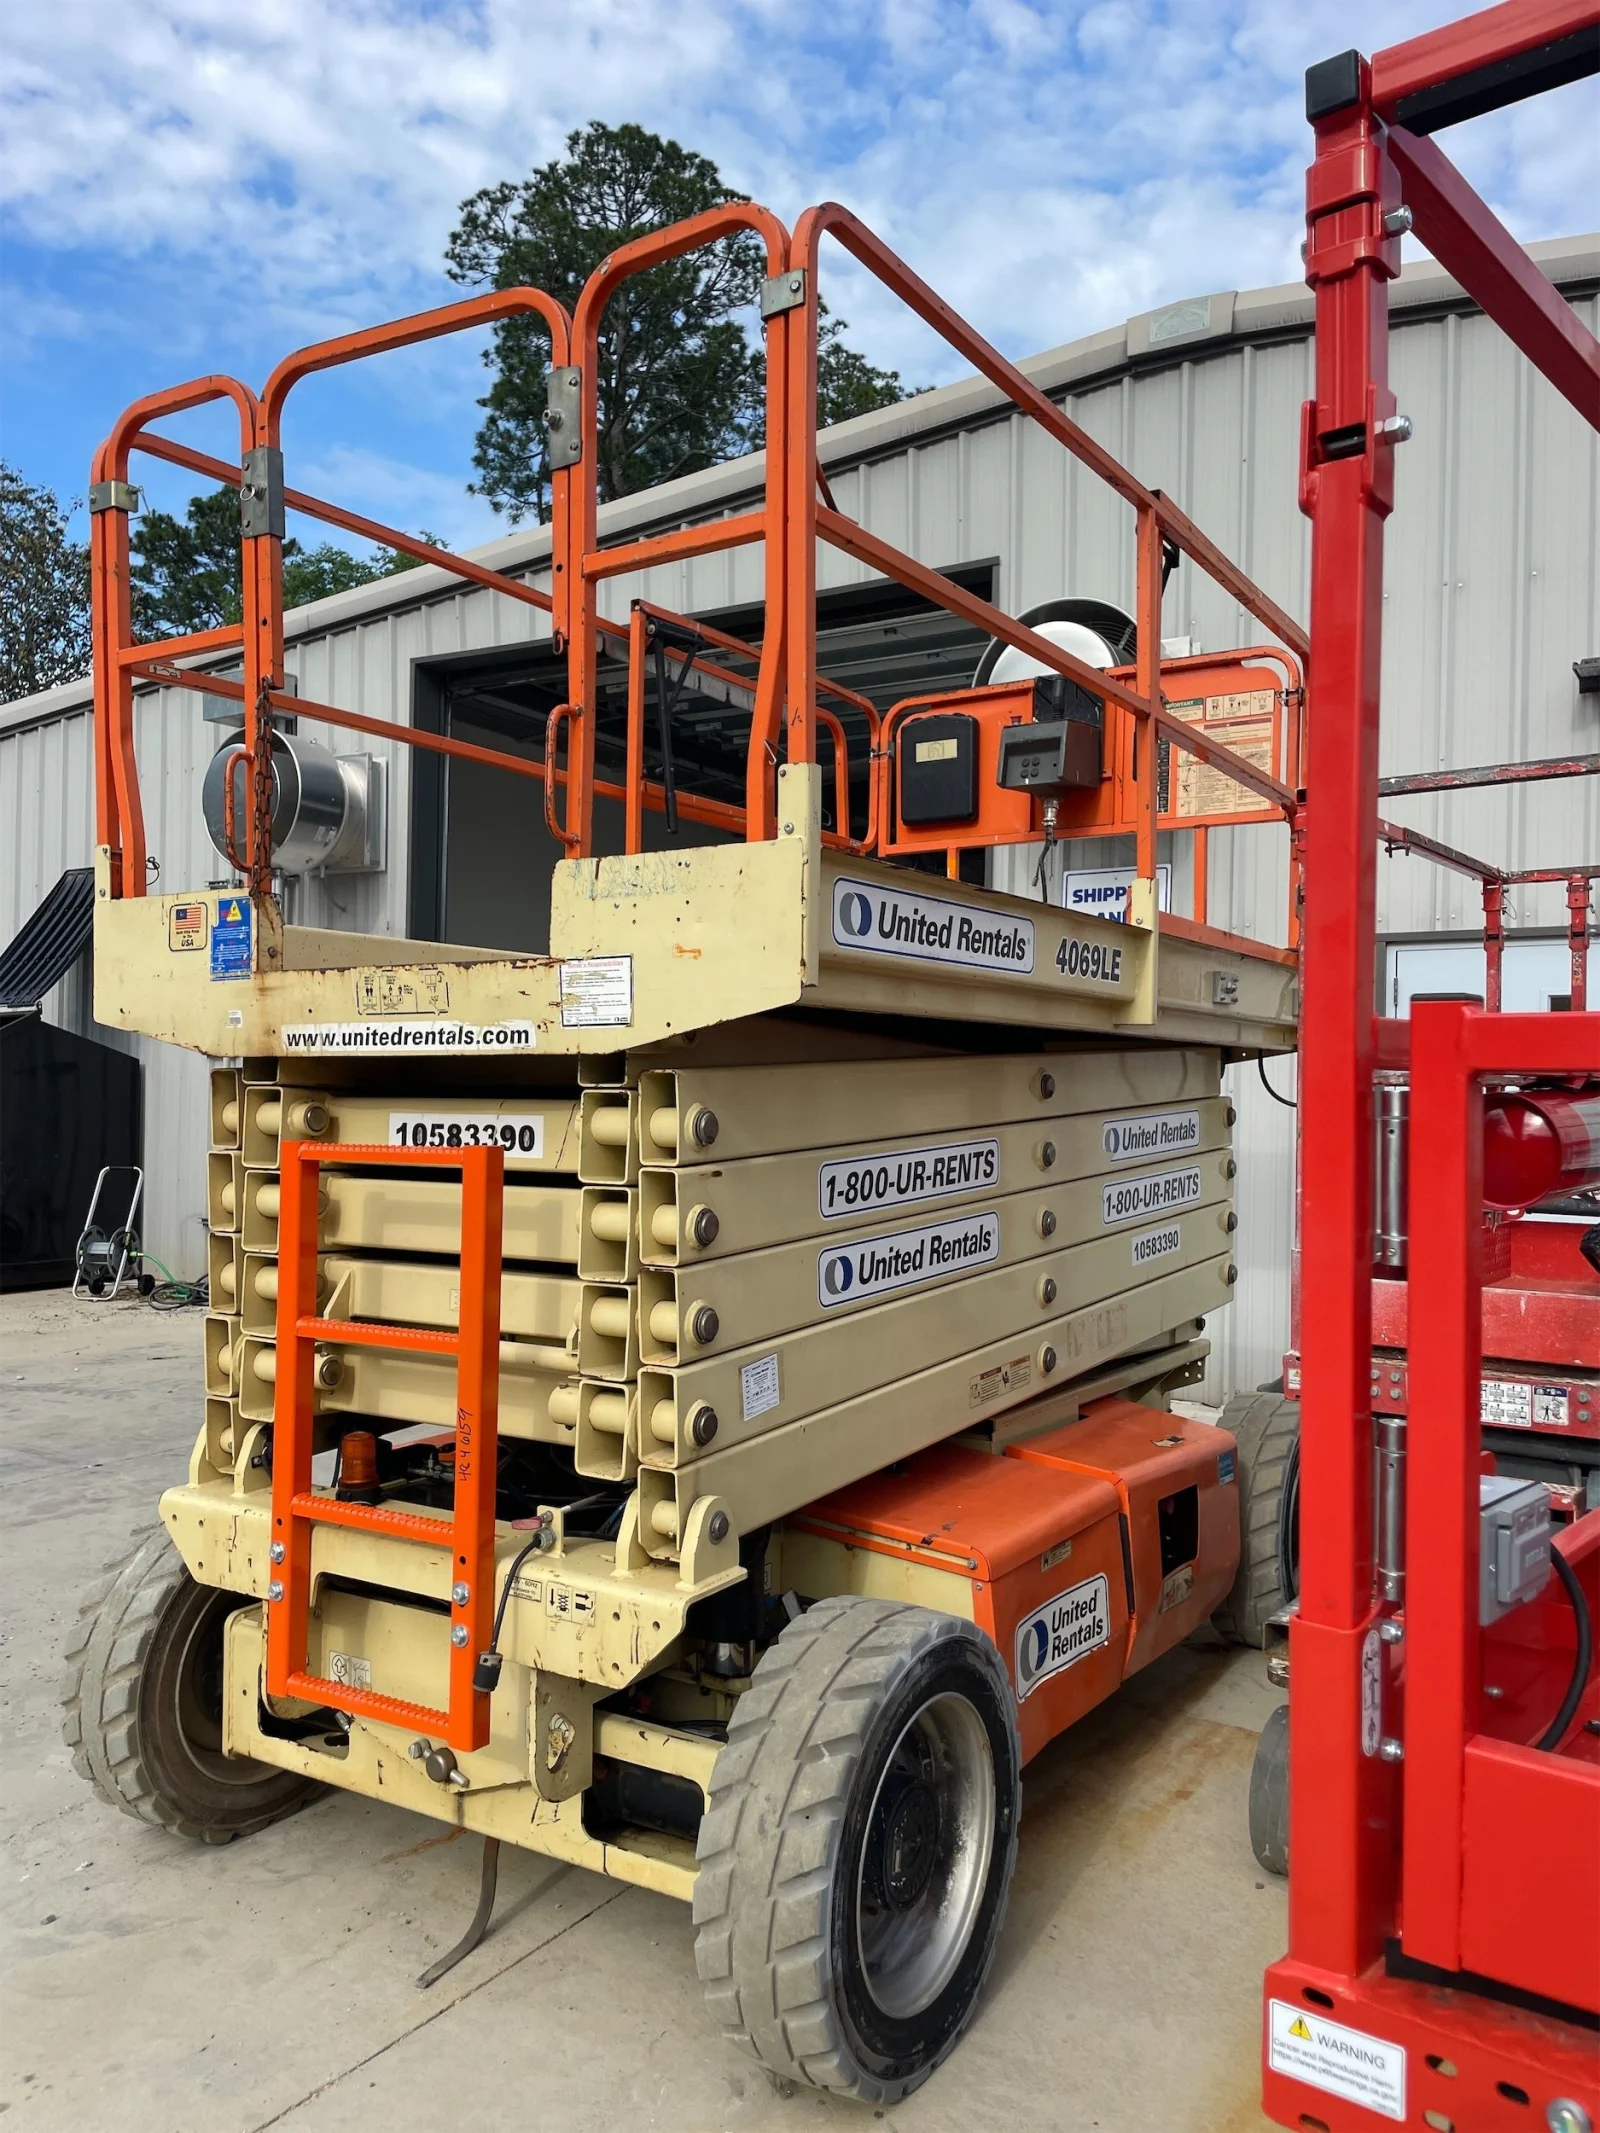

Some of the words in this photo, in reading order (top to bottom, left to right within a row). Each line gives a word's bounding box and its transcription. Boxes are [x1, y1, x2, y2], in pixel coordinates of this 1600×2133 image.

[1072, 886, 1132, 904] SHIPP
[181, 939, 194, 947] USA
[878, 901, 952, 949] United
[957, 918, 1026, 961] Rentals
[1055, 938, 1121, 982] 4069LE
[287, 1026, 530, 1047] www.unitedrentals.com
[396, 1122, 536, 1152] 10583390
[1122, 1123, 1158, 1151] United
[1160, 1118, 1196, 1145] Rentals
[826, 1149, 995, 1208] 1-800-UR-RENTS
[1106, 1172, 1199, 1218] 1-800-UR-RENTS
[858, 1239, 925, 1286] United
[929, 1224, 992, 1267] Rentals
[1134, 1230, 1179, 1261] 10583390
[1052, 1589, 1098, 1634] United
[1052, 1615, 1103, 1661] Rentals
[1273, 2037, 1300, 2053] Cancer
[1301, 2049, 1317, 2061] and
[1318, 2054, 1369, 2082] Reproductive
[1316, 2032, 1386, 2070] WARNING
